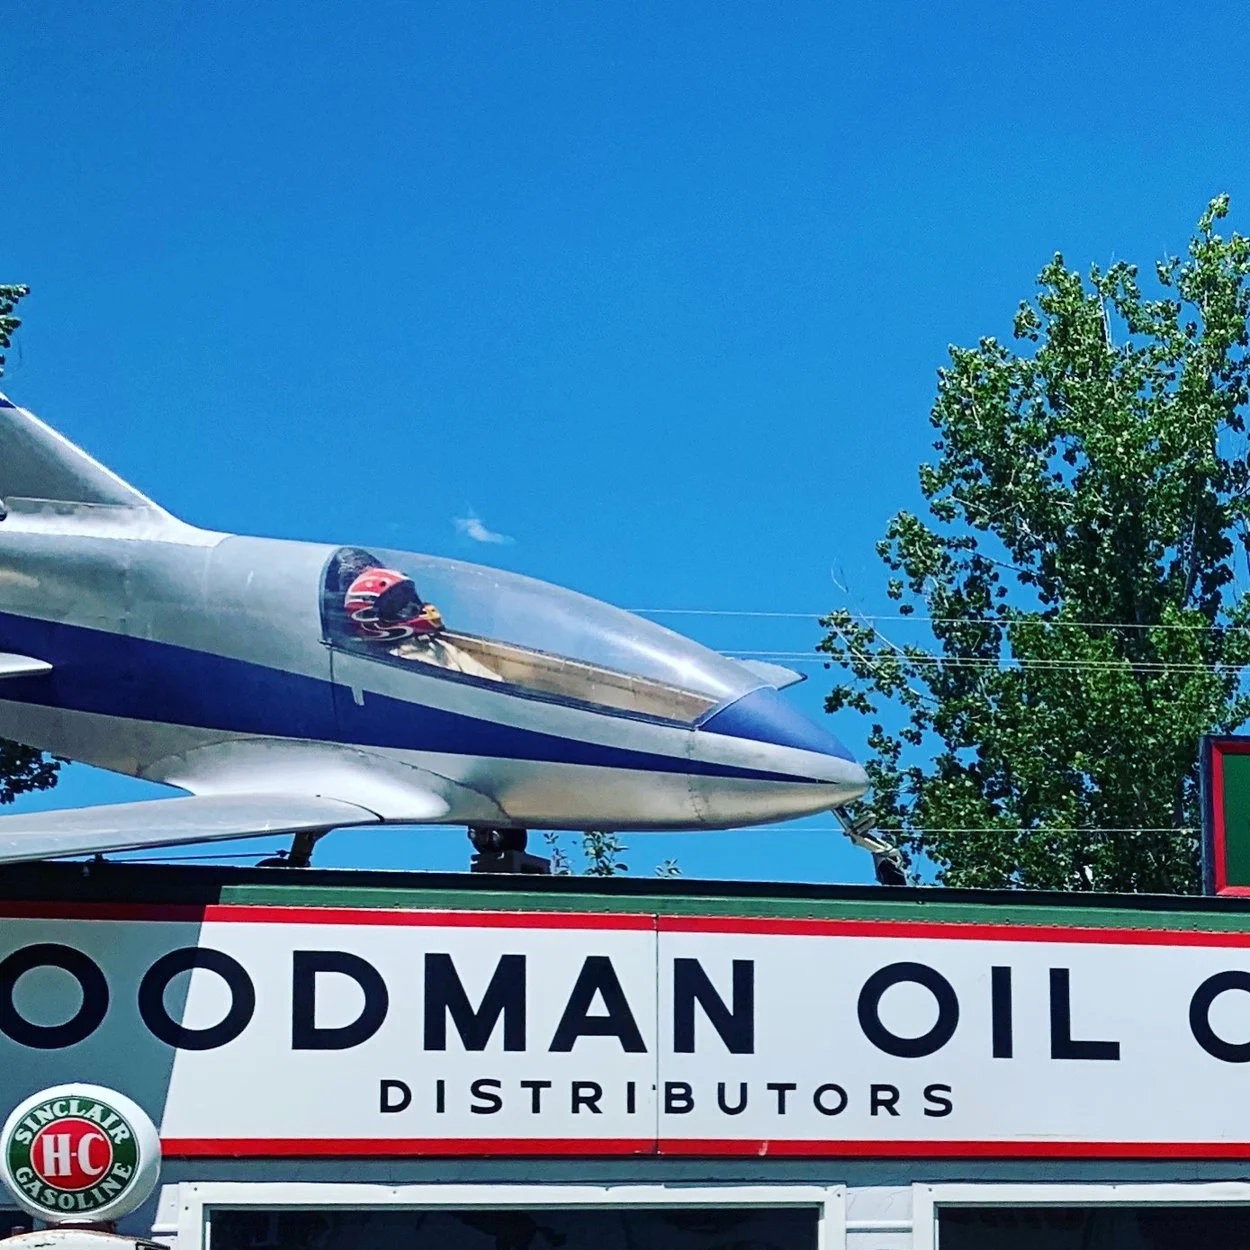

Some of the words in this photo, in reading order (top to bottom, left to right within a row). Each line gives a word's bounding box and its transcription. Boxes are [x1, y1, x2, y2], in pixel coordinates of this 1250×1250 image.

[858, 961, 1120, 1061] OIL
[380, 1078, 953, 1118] DISTRIBUTORS
[14, 1099, 131, 1145] SINCLAIR
[41, 1132, 105, 1177] H-C
[15, 1162, 132, 1209] GASOLINE
